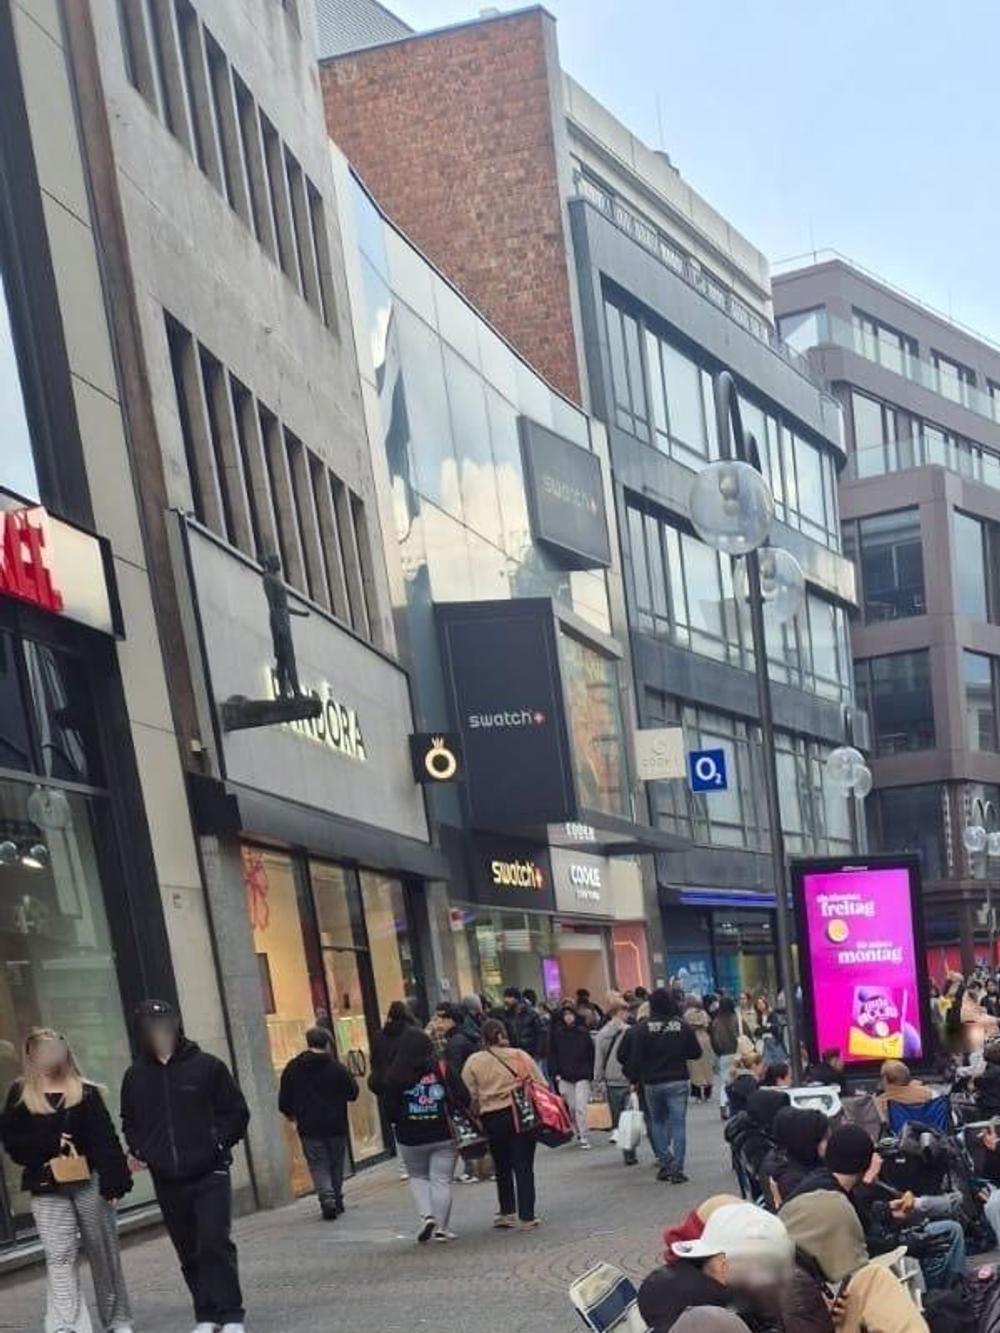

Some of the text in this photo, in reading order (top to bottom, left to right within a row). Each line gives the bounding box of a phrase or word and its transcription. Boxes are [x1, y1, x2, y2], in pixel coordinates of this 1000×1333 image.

[268, 665, 367, 761] DORA
[469, 709, 532, 728] swatch
[491, 860, 536, 888] swatch
[821, 899, 876, 917] freitag
[837, 946, 903, 965] montag
